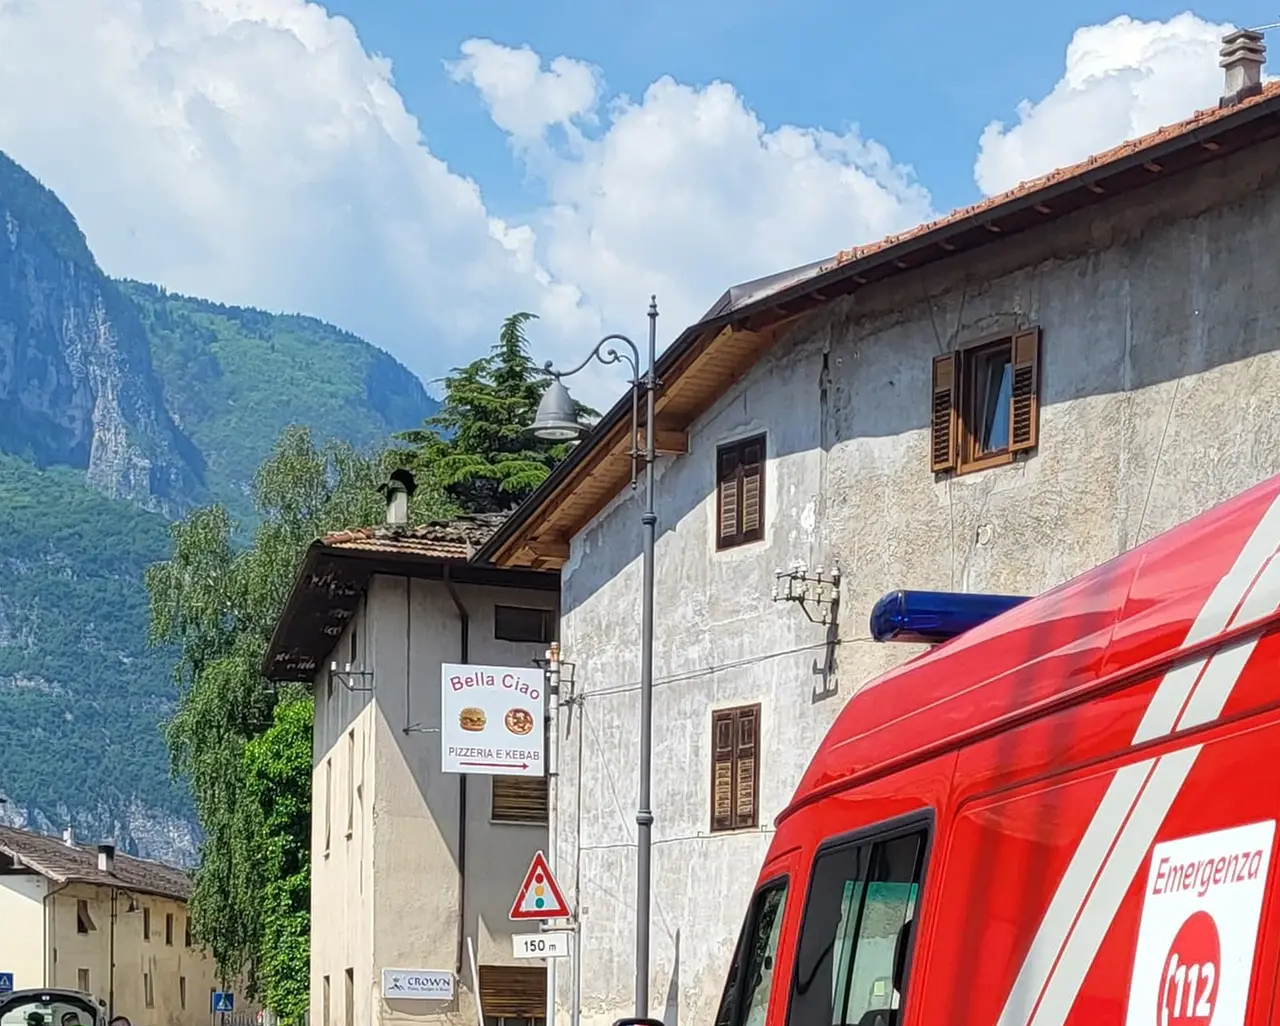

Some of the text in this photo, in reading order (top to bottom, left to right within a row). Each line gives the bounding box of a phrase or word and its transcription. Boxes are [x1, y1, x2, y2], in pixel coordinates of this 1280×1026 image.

[450, 671, 540, 700] Bella Ciao
[448, 747, 540, 760] PIZZERIA E KEBAB
[1152, 849, 1263, 898] Emergenza
[524, 940, 557, 952] 150 m
[407, 976, 450, 987] CROWN
[1173, 961, 1216, 1018] 112
